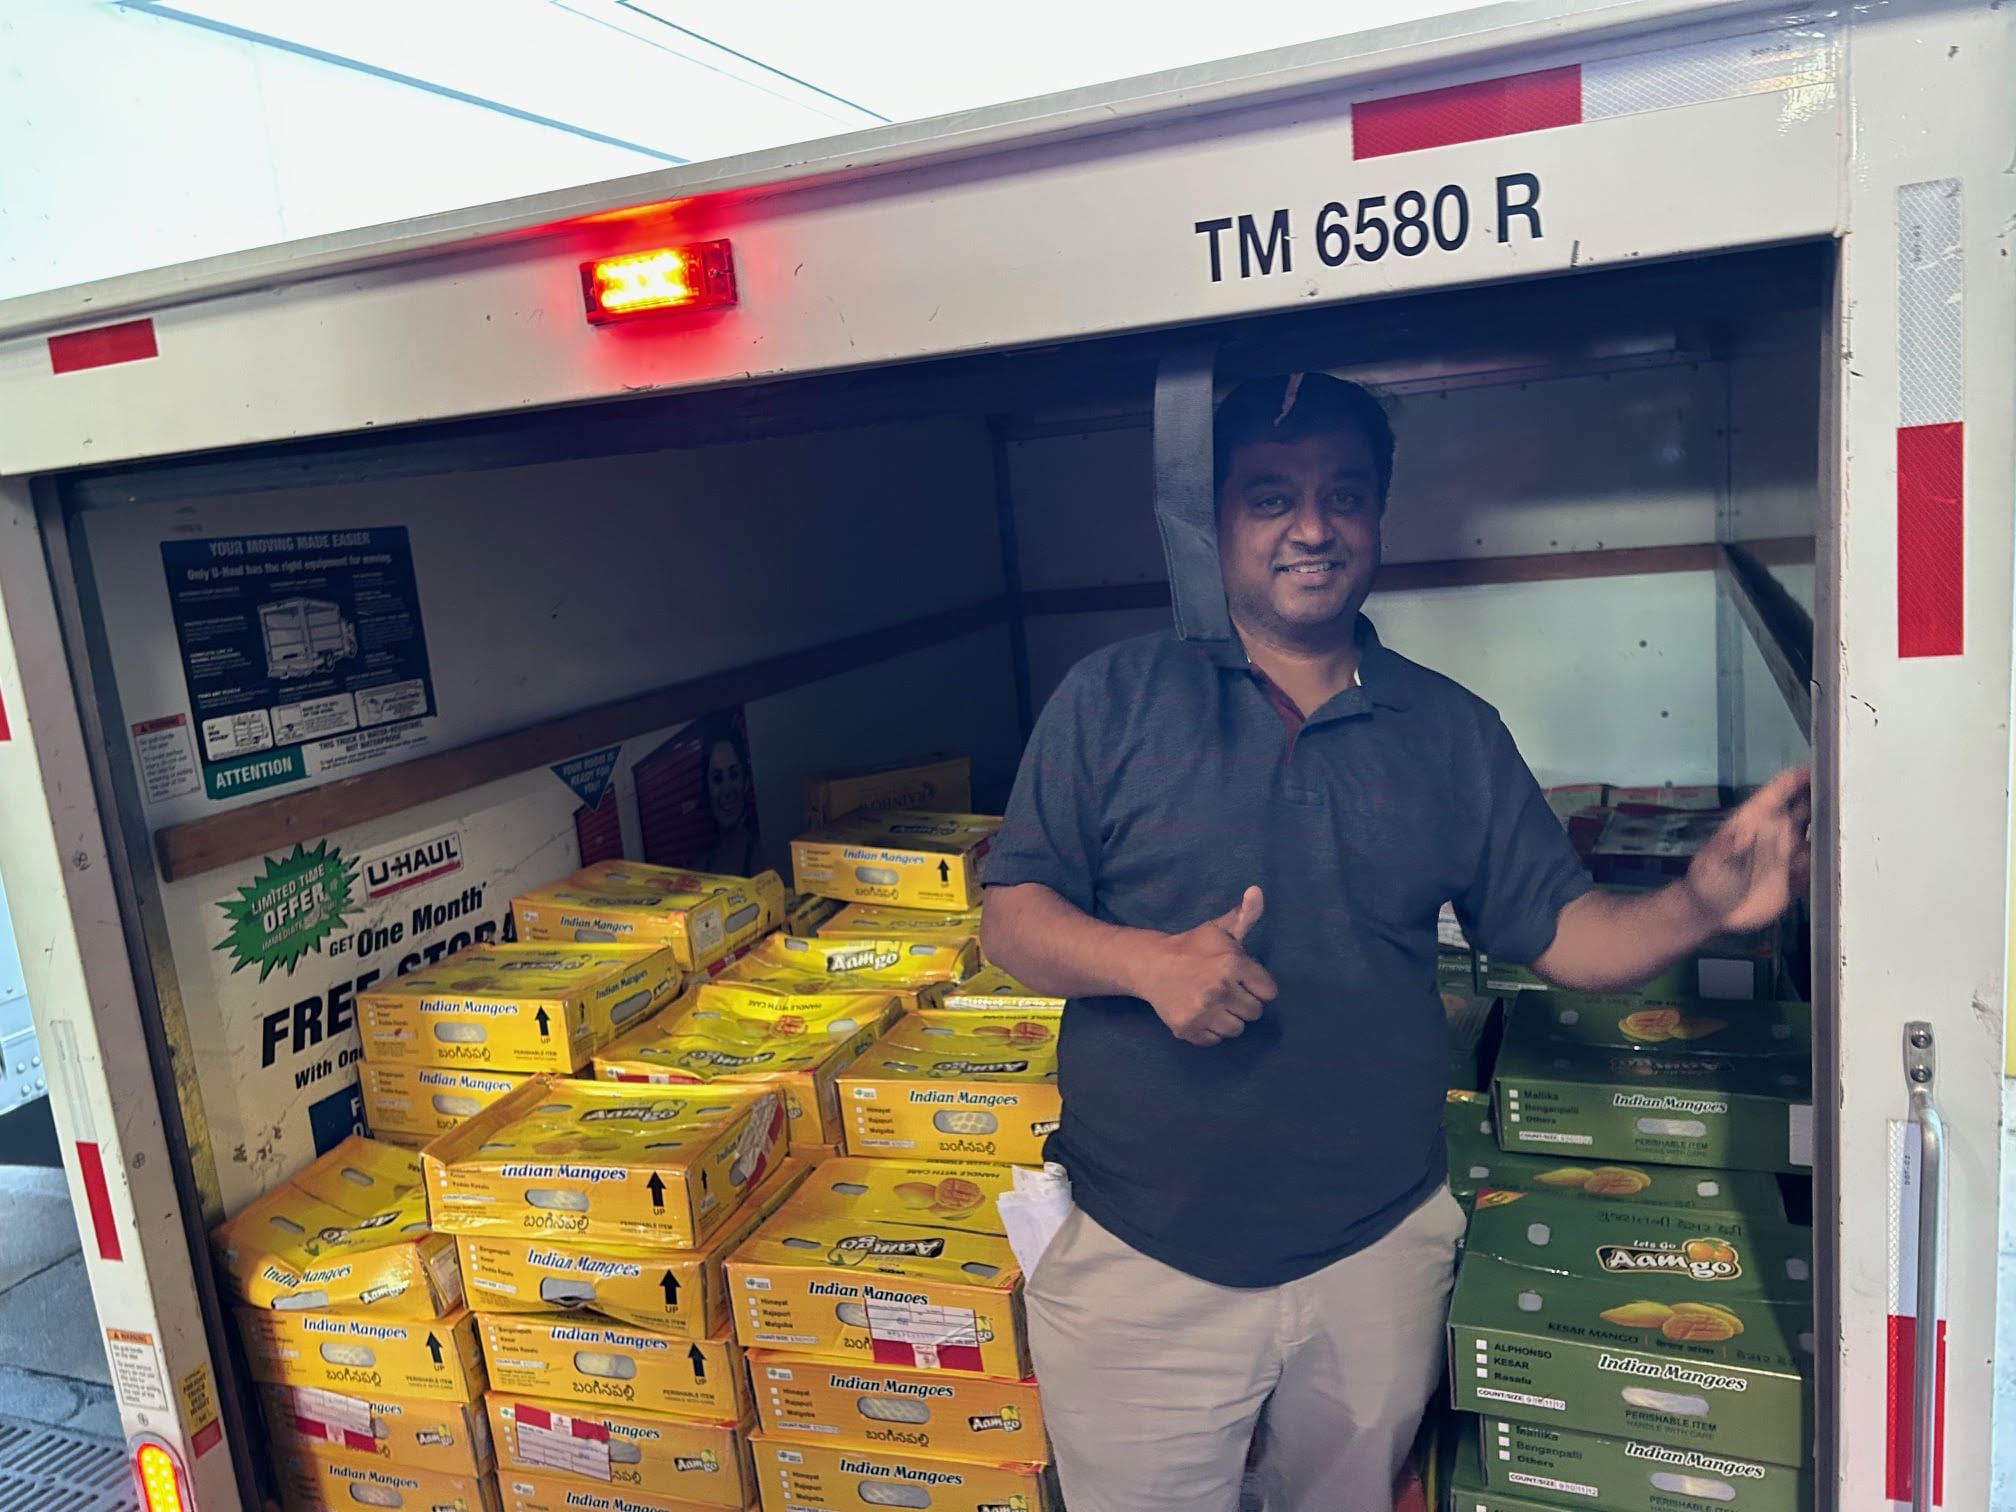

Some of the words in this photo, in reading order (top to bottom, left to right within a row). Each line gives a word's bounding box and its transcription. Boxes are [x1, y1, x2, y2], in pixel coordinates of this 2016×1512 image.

[1194, 208, 1291, 282] TM
[1316, 184, 1469, 267] 6580
[1496, 172, 1544, 243] R
[208, 541, 244, 557] YOUR
[246, 537, 294, 554] MOVING
[296, 534, 329, 550] MADE
[216, 756, 293, 791] ATTENTION
[843, 848, 877, 861] Indian
[880, 852, 925, 866] Mangoes
[251, 880, 296, 915] LIMITED
[299, 864, 325, 888] TIME
[263, 882, 327, 933] OFFER
[560, 916, 591, 929] Indian
[593, 919, 634, 933] Mangoes
[330, 933, 354, 957] GET
[357, 918, 403, 958] One
[828, 950, 899, 971] Aamgo
[419, 999, 462, 1013] Indian
[463, 1001, 519, 1016] Mangoes
[295, 1056, 333, 1089] With
[418, 1071, 457, 1086] Indian
[459, 1075, 512, 1092] Mangoes
[909, 1090, 955, 1104] Indian
[958, 1091, 1019, 1107] Mangoes
[1613, 1093, 1661, 1109] Indian
[1662, 1096, 1727, 1114] Mangoes
[1033, 1121, 1060, 1135] Aam
[1686, 1141, 1709, 1150] ITEM
[557, 1165, 627, 1182] Mangoes
[960, 1170, 1000, 1179] HANDLE
[653, 1207, 666, 1216] UP
[842, 1236, 940, 1257] Aamgo
[1660, 1241, 1677, 1250] Go
[528, 1249, 571, 1269] Indian
[574, 1255, 640, 1277] Mangoes
[1609, 1250, 1733, 1278] Aamgo
[809, 1282, 859, 1298] Indian
[665, 1305, 679, 1314] UP
[304, 1318, 346, 1334] Indian
[349, 1322, 407, 1339] Mangoes
[551, 1326, 600, 1341] Indian
[604, 1331, 668, 1349] Mangoes
[1548, 1323, 1586, 1336] KESAR
[1589, 1330, 1639, 1345] MANGO
[1494, 1343, 1553, 1359] ALPHONSO
[433, 1364, 445, 1372] UP
[1494, 1357, 1529, 1370] KESAR
[1599, 1355, 1660, 1378] Indian
[1664, 1364, 1747, 1391] Mangoes
[830, 1375, 880, 1391] Indian
[884, 1380, 954, 1398] Mangoes
[369, 1401, 403, 1415] ngoes
[603, 1420, 661, 1439] Mangoes
[971, 1416, 1021, 1431] Aamgo
[1625, 1410, 1689, 1428] PERISHABLE
[1692, 1418, 1717, 1432] ITEM
[677, 1457, 718, 1472] Aamgo
[1517, 1454, 1554, 1468] Others
[1627, 1442, 1684, 1464] Indian
[1687, 1452, 1764, 1478] Mangoes
[329, 1464, 366, 1480] Indian
[368, 1471, 418, 1489] Mangoes
[840, 1459, 890, 1476] Indian
[894, 1466, 963, 1485] Mangoes
[566, 1492, 603, 1507] Indian
[605, 1497, 670, 1512] Mangoes
[1650, 1495, 1712, 1512] PERISHABLE
